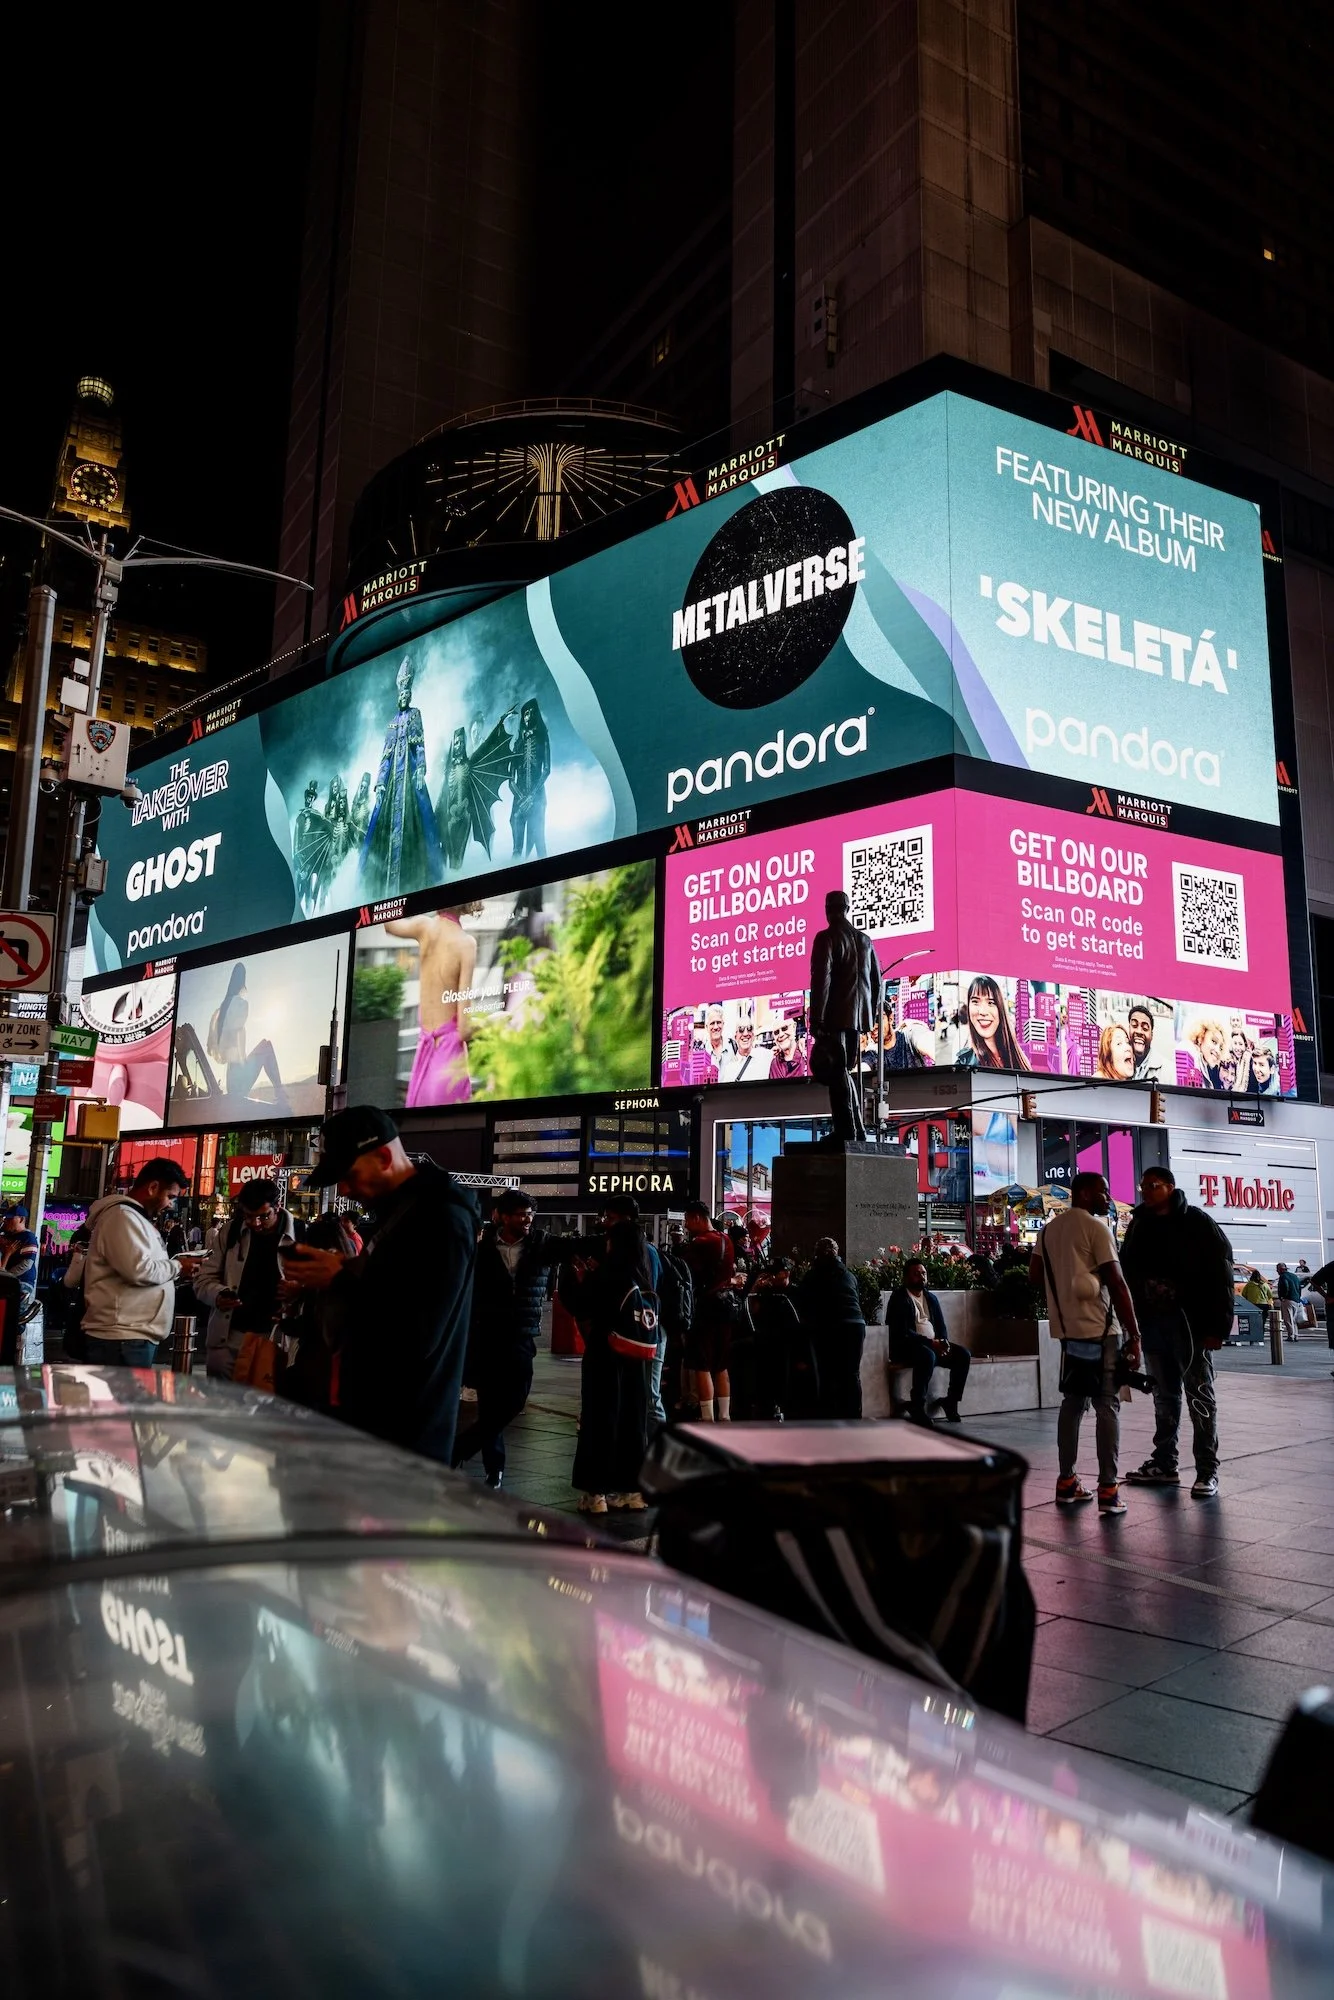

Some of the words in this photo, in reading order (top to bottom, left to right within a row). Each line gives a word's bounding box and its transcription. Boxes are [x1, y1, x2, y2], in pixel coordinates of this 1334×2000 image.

[1111, 420, 1188, 460] MARRIOTT
[1112, 439, 1180, 473] MARQUIS
[708, 434, 785, 481] MARRIOTT
[707, 456, 775, 496] MARQUIS
[996, 446, 1149, 525] FEATURING
[1153, 501, 1225, 551] THEIR
[1032, 492, 1099, 539] NEW
[1104, 518, 1196, 573] ALBUM
[362, 579, 417, 612] MARQUIS
[363, 561, 427, 596] MARRIOTT
[672, 536, 866, 651] METALVERSE
[205, 712, 236, 733] MARQUIS
[206, 699, 242, 723] MARRIOTT
[667, 714, 868, 814] pandora
[1025, 707, 1221, 787] pandora
[170, 758, 190, 782] THE
[131, 759, 229, 826] TAKEOVER
[1117, 794, 1172, 815] MARRIOTT
[162, 806, 190, 832] WITH
[698, 810, 752, 831] MARRIOTT
[698, 823, 745, 843] MARQUIS
[1118, 807, 1167, 826] MARQUIS
[125, 832, 222, 902] GHOST
[1009, 829, 1056, 861] GET
[1061, 838, 1095, 869] ON
[1100, 846, 1148, 879] OUR
[683, 868, 724, 898] GET
[728, 860, 760, 889] ON
[766, 849, 815, 881] OUR
[1017, 859, 1143, 906] BILLBOARD
[373, 897, 408, 913] MARRIOTT
[373, 908, 403, 921] MARQUIS
[689, 879, 809, 924] BILLBOARD
[1021, 897, 1065, 924] Scan
[1070, 906, 1096, 929] QR
[1102, 916, 1143, 937] code
[127, 907, 205, 958] pandora
[691, 931, 729, 951] Scan
[734, 922, 759, 943] QR
[764, 915, 807, 938] code
[1021, 923, 1040, 944] to
[1046, 930, 1076, 951] get
[1081, 933, 1143, 960] started
[154, 956, 177, 968] MARRIOTT
[154, 964, 174, 976] MARQUIS
[690, 956, 707, 972] to
[711, 949, 738, 973] get
[743, 937, 806, 963] started
[441, 986, 479, 1004] Glossier
[503, 980, 530, 995] FLEUR
[912, 990, 926, 1001] NYC
[16, 1024, 42, 1036] ZONE
[60, 1033, 87, 1047] WAY
[668, 1061, 679, 1069] NYC
[614, 1098, 660, 1111] SEPHORA
[588, 1174, 674, 1193] SEPHORA
[1222, 1176, 1295, 1212] Mobile
